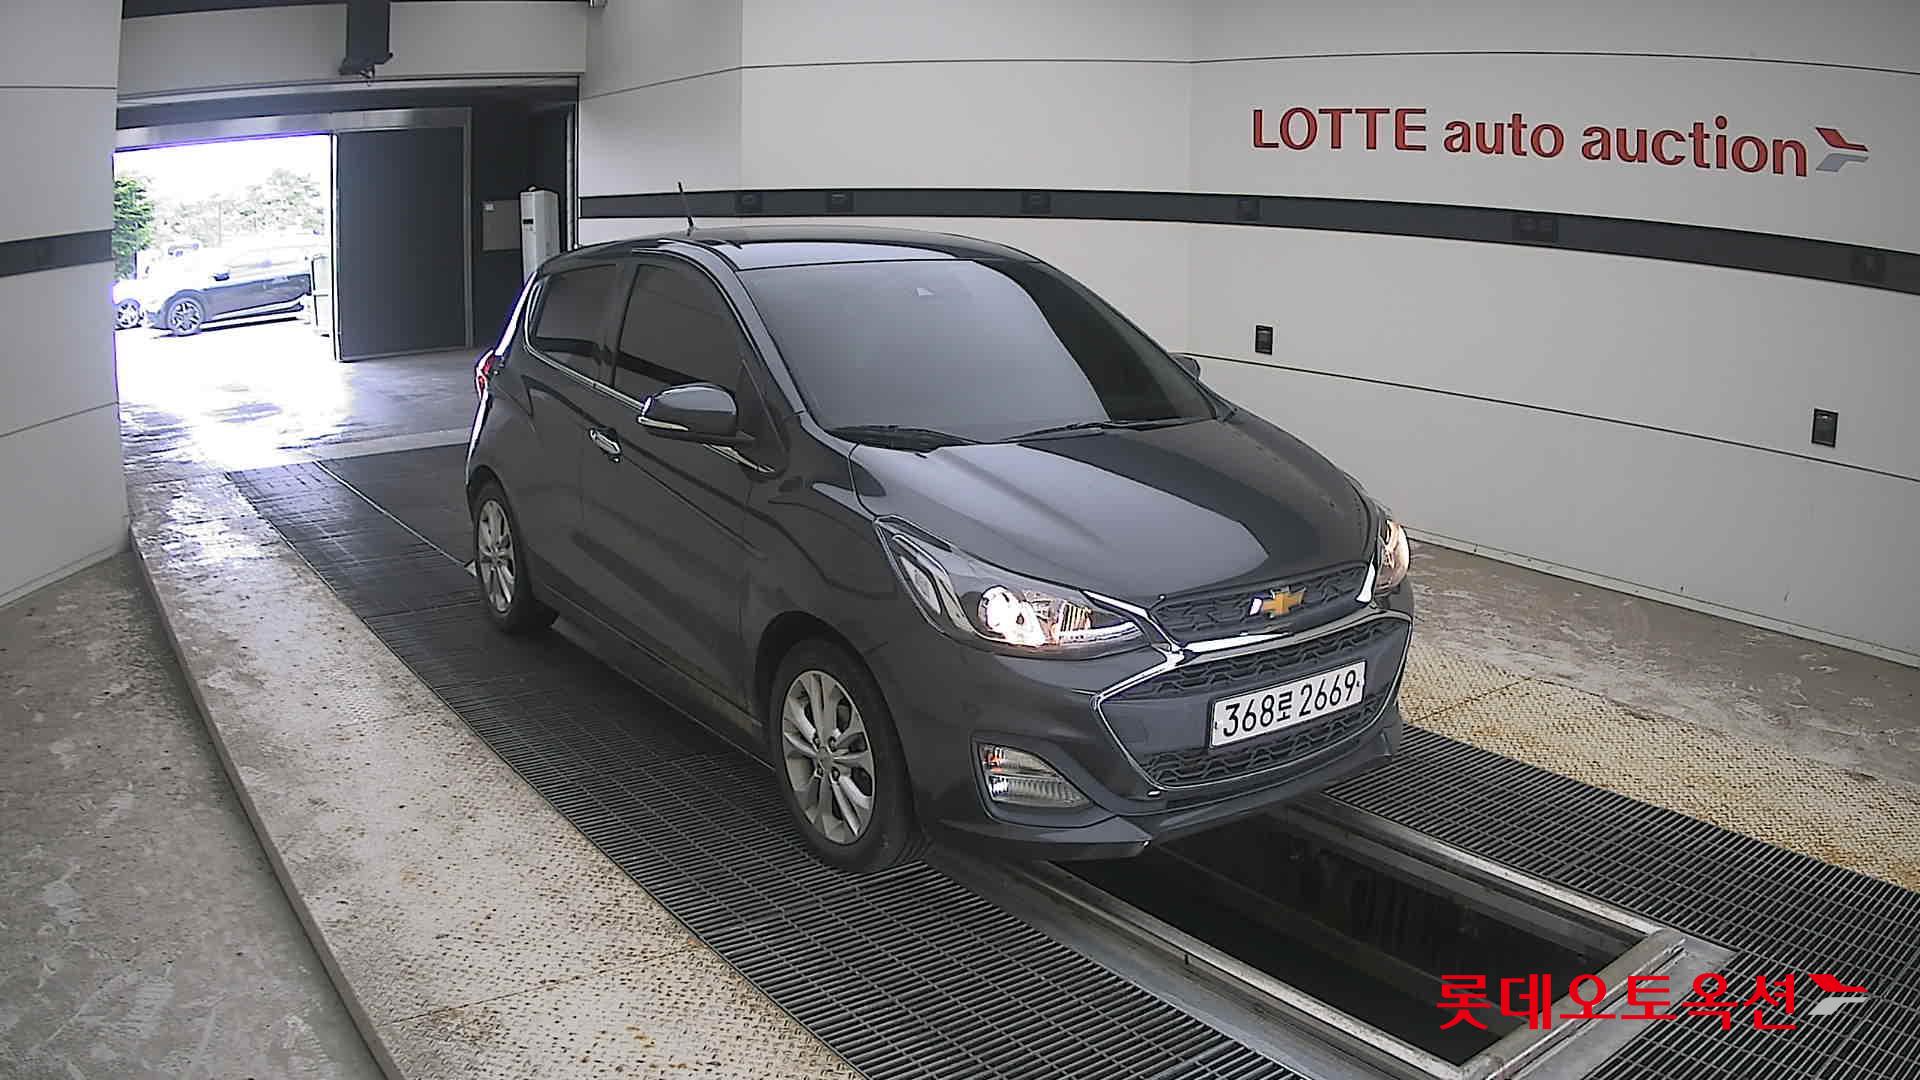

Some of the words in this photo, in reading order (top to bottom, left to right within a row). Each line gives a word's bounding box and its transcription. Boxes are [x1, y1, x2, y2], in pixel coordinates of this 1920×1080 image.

[1253, 107, 1427, 151] LOTTE
[1443, 113, 1565, 158] auto
[1581, 115, 1808, 177] auction
[1223, 690, 1293, 737] 368로
[1299, 669, 1356, 717] 2669
